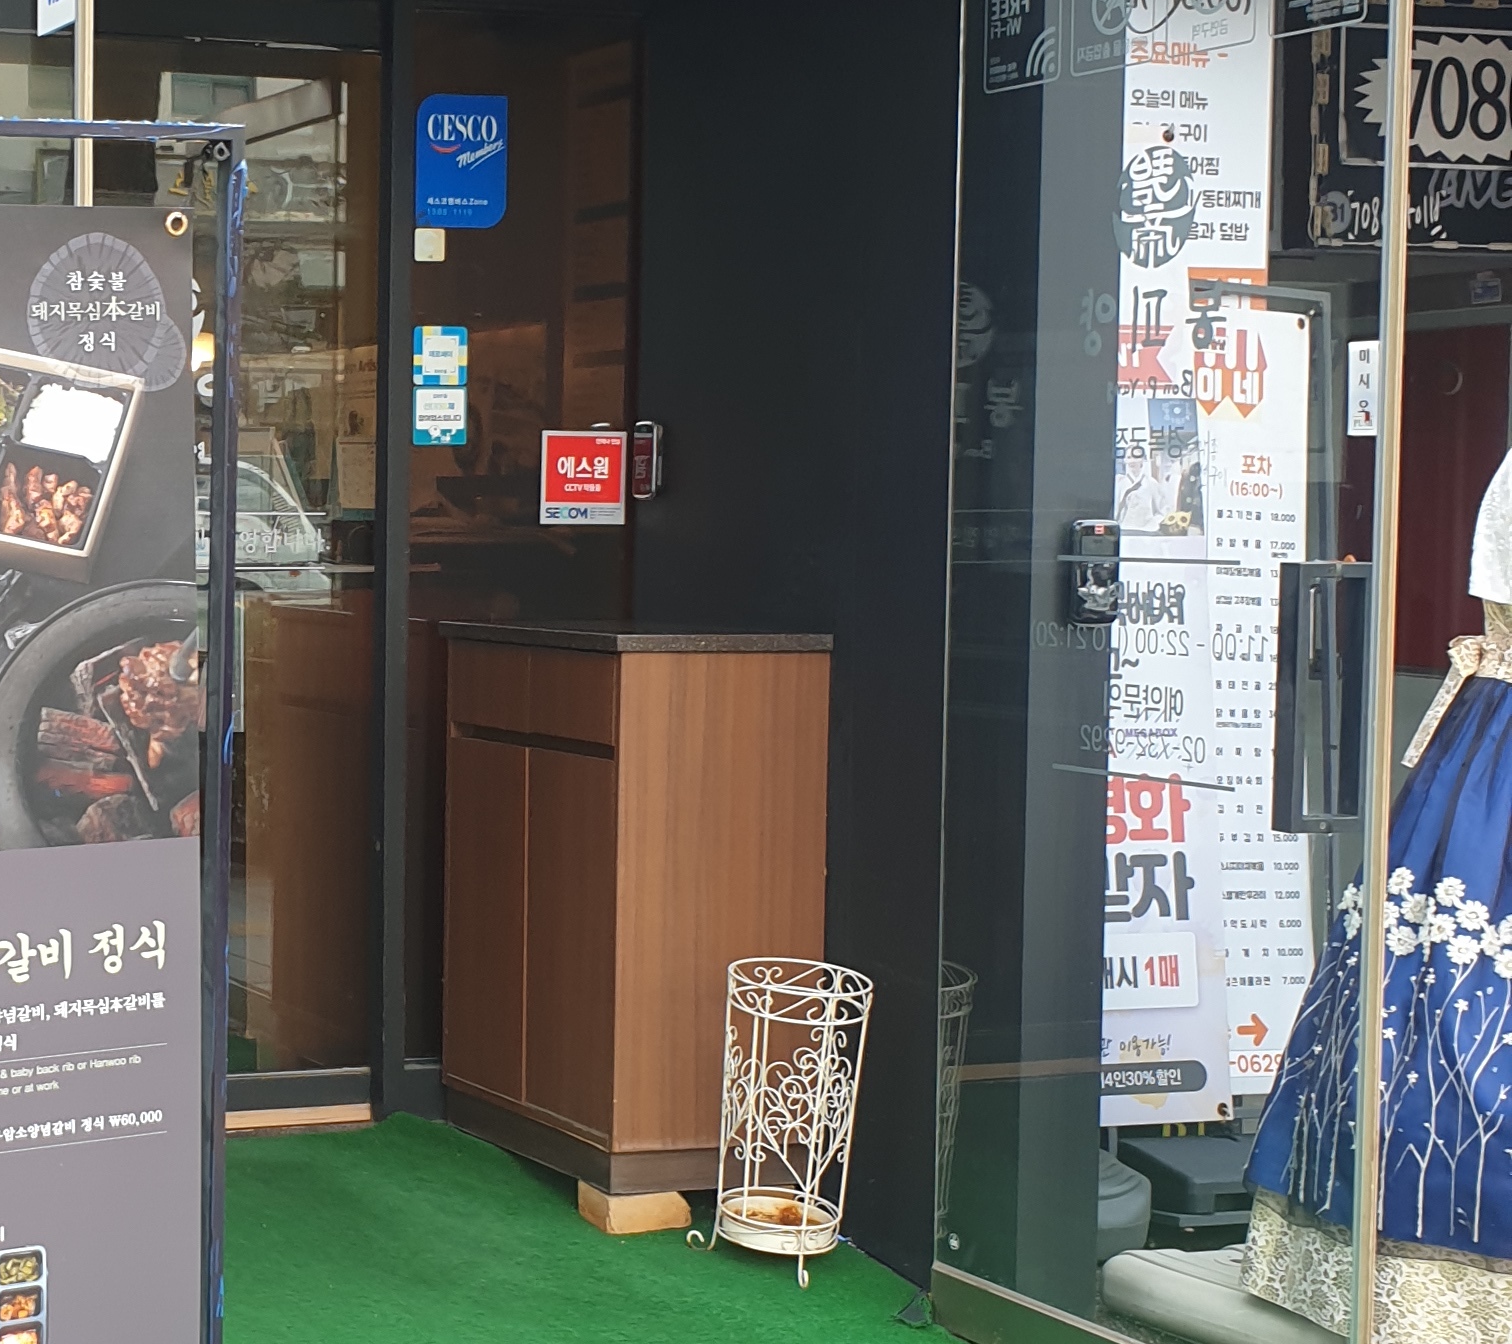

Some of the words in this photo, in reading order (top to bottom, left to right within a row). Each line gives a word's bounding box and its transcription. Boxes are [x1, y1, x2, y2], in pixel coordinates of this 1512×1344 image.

[1130, 88, 1176, 109] 오늘의
[1179, 90, 1209, 111] 메뉴
[1407, 56, 1512, 142] 708
[427, 114, 498, 142] CESCO
[1179, 123, 1208, 143] 구이
[1190, 189, 1262, 209] /동태찌개
[1188, 221, 1216, 241] 음과
[1219, 222, 1250, 242] 덮밥
[31, 296, 161, 321] 돼지목심本갈비
[77, 331, 116, 352] 정식
[557, 456, 609, 479] 에스원
[1241, 455, 1272, 476] 포차
[1230, 480, 1283, 500] (16:00~)
[545, 507, 588, 519] SECOM
[238, 530, 331, 557] 영합니다.
[88, 920, 166, 974] 정식
[1144, 954, 1180, 987] 1매
[53, 992, 166, 1019] 돼지목심本갈비를
[0, 1069, 8, 1079] &
[10, 1067, 35, 1080] baby
[36, 1063, 60, 1075] back
[62, 1061, 75, 1071] rib
[76, 1061, 88, 1070] or
[89, 1058, 127, 1070] Hanwoo
[128, 1054, 141, 1065] rib
[11, 1086, 22, 1094] or
[36, 1080, 60, 1092] work
[80, 1115, 105, 1133] 정식
